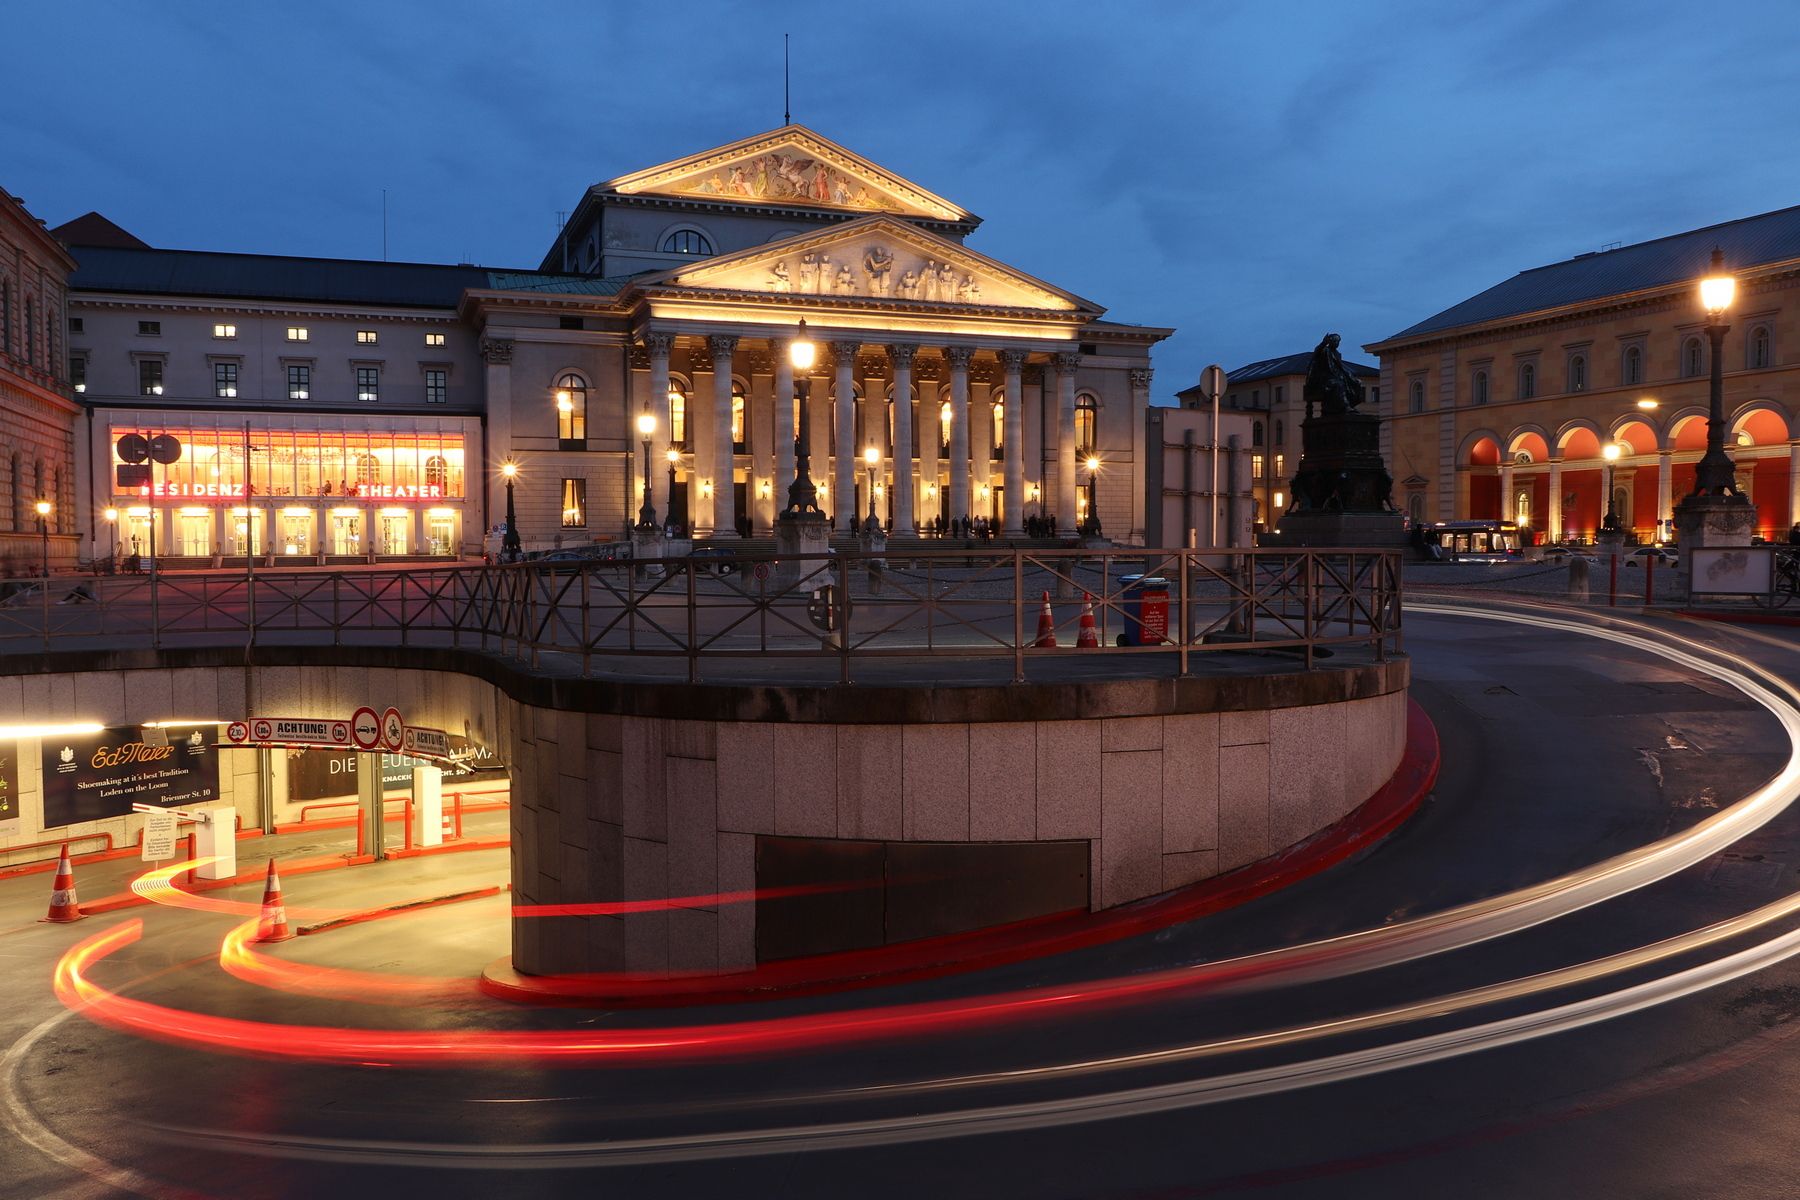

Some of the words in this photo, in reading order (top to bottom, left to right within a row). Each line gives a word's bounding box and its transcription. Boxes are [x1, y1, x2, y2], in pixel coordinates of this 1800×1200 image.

[357, 484, 440, 498] THEATER
[277, 722, 327, 734] ACHTUNG!
[330, 757, 356, 774] DIE
[77, 777, 122, 790] Shoemaking
[143, 772, 158, 780] best
[159, 768, 189, 778] Tradition
[100, 788, 123, 798] Loden
[135, 784, 147, 792] the
[148, 781, 169, 790] Loom
[161, 793, 191, 803] Brienner
[191, 790, 201, 798] St.
[203, 788, 211, 796] 10
